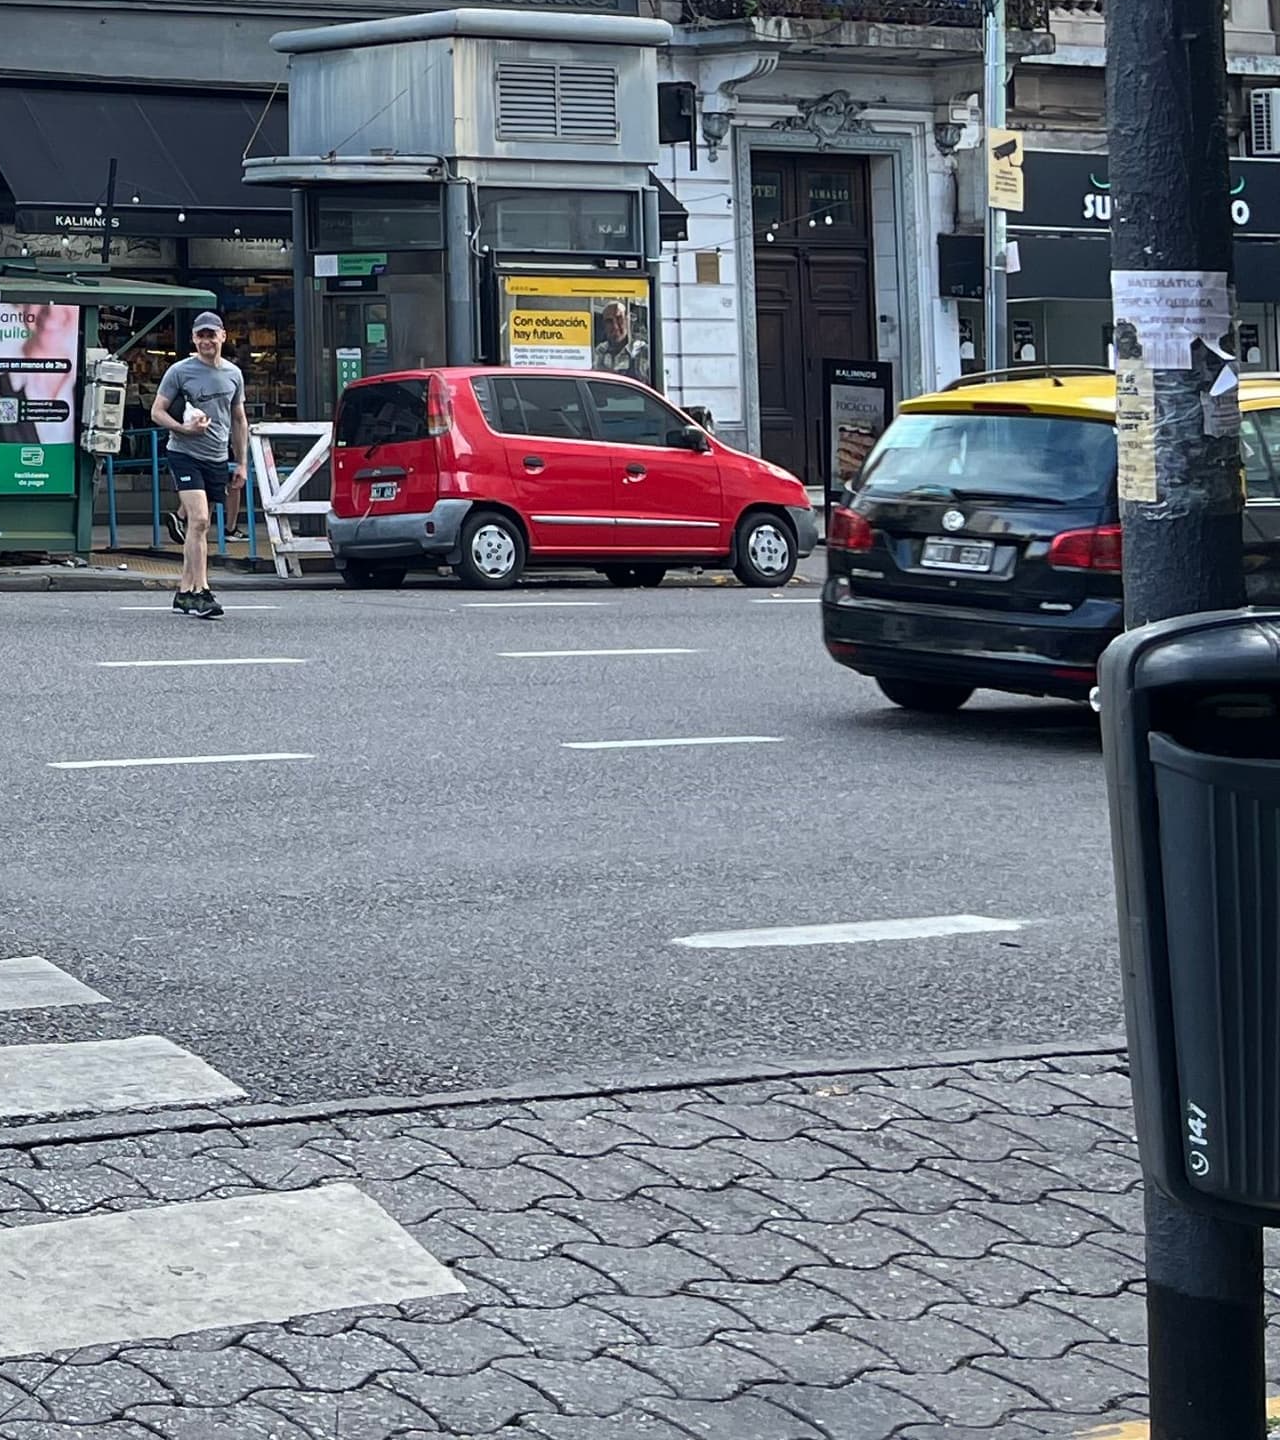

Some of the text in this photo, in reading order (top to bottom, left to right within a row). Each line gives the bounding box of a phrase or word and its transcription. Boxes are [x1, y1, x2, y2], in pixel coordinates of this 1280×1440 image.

[513, 316, 587, 329] Con educación,
[514, 329, 563, 340] hay futuro.
